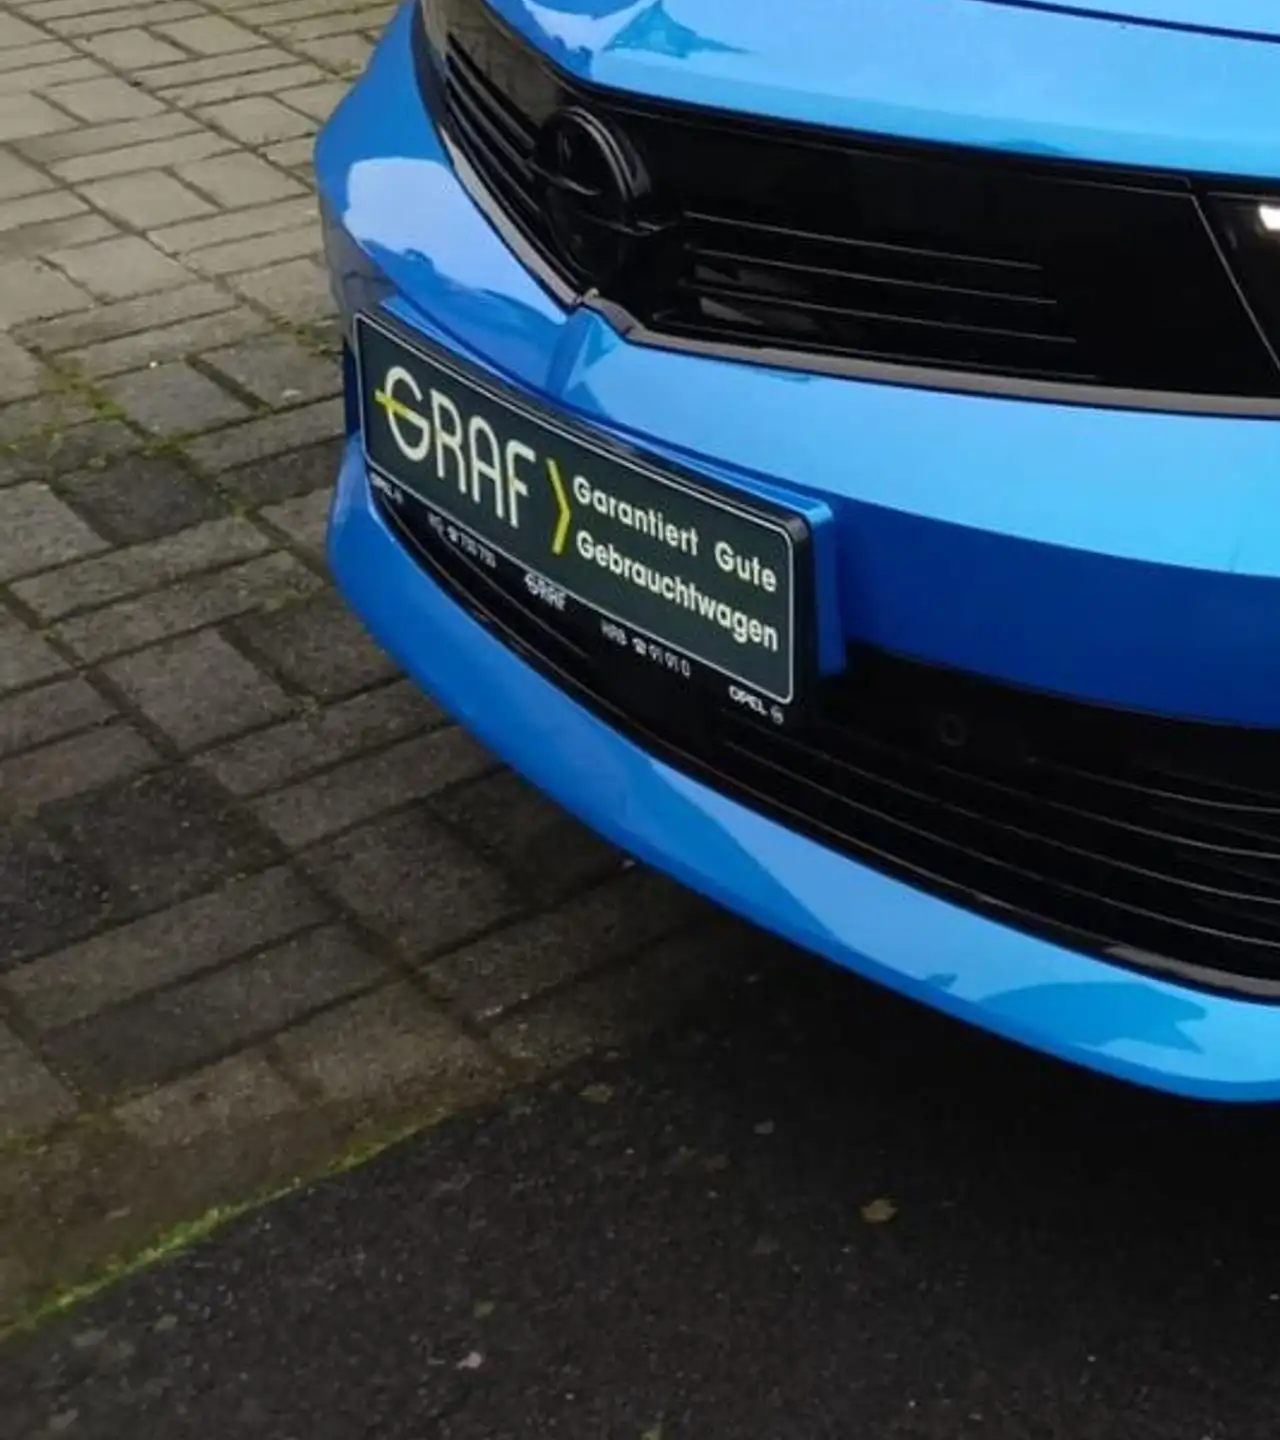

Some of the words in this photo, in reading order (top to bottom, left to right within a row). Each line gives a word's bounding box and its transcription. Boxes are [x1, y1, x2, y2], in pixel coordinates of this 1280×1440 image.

[374, 365, 537, 529] GRAF
[572, 474, 700, 557] Garantiert
[714, 540, 778, 593] Gute
[575, 529, 779, 654] Gebrauchtwagen
